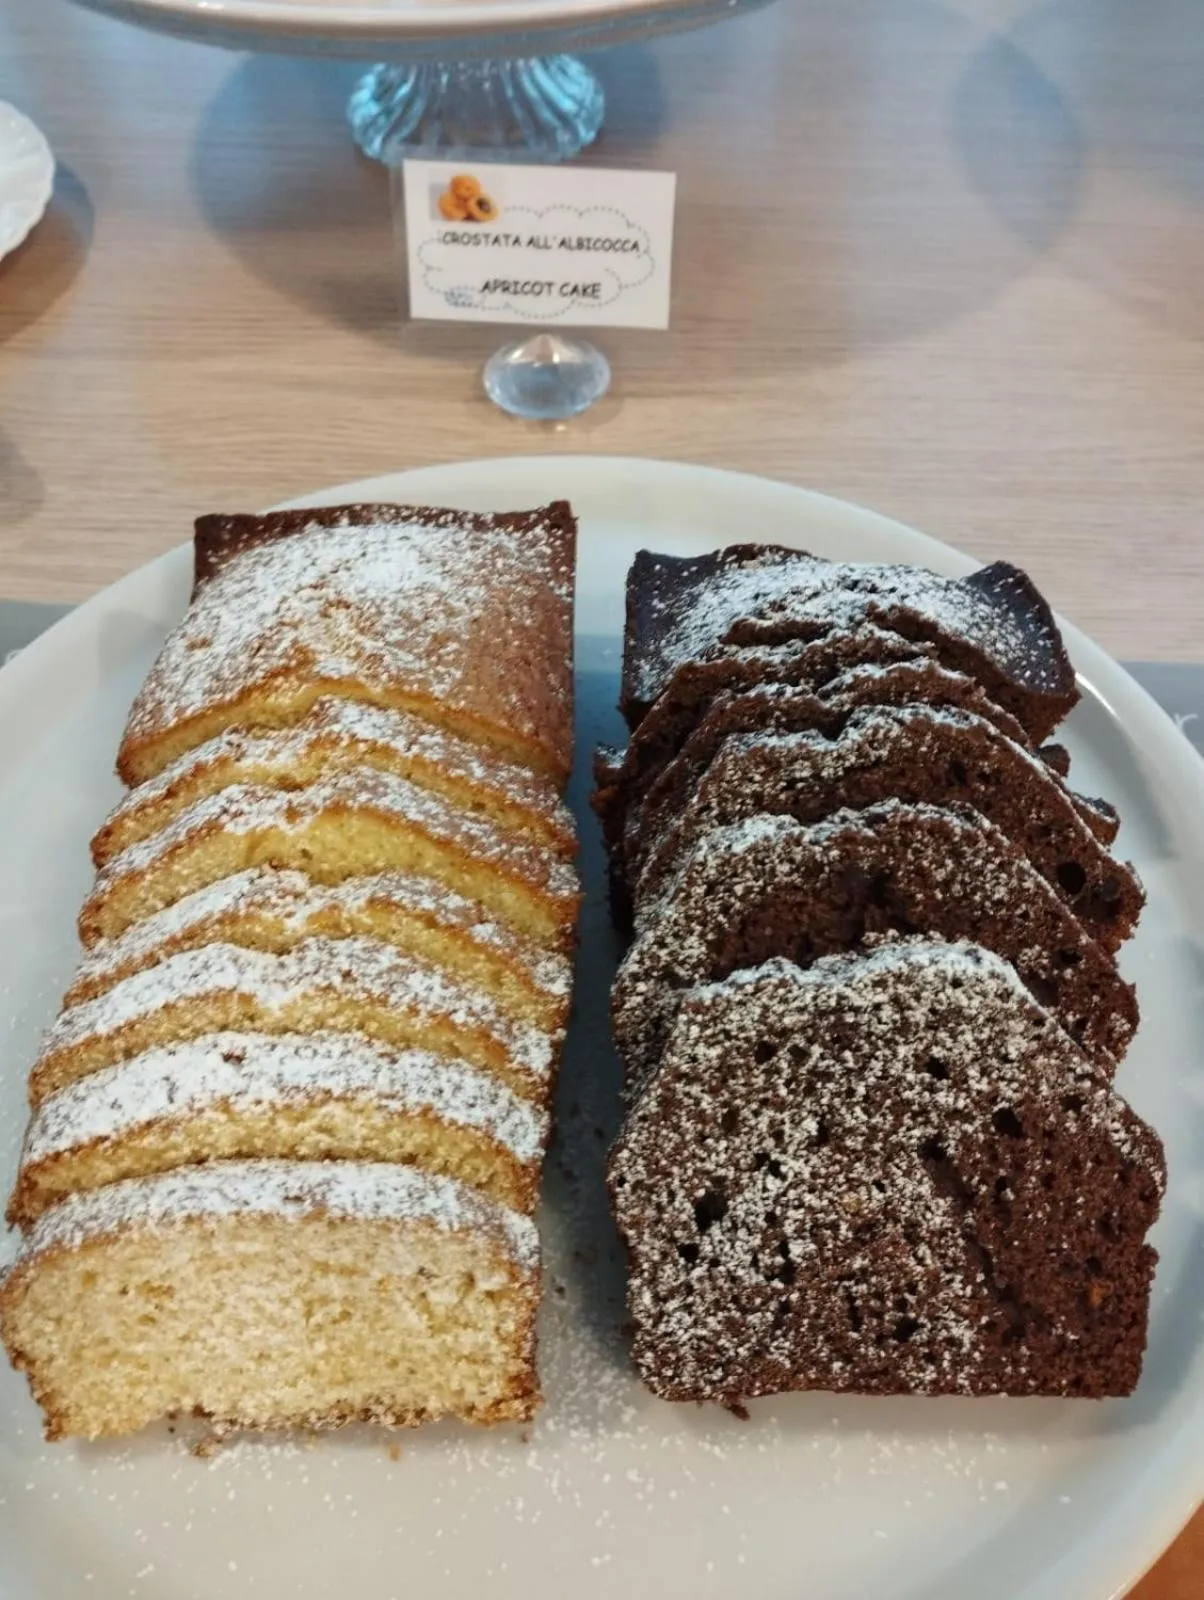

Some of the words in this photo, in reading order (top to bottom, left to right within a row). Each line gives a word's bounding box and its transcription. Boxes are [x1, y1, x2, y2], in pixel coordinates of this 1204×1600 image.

[441, 231, 522, 246] CROSTATA
[526, 235, 640, 252] ALL'ALBICOCCA
[481, 279, 554, 296] APRICOT
[558, 281, 602, 299] CAKE
